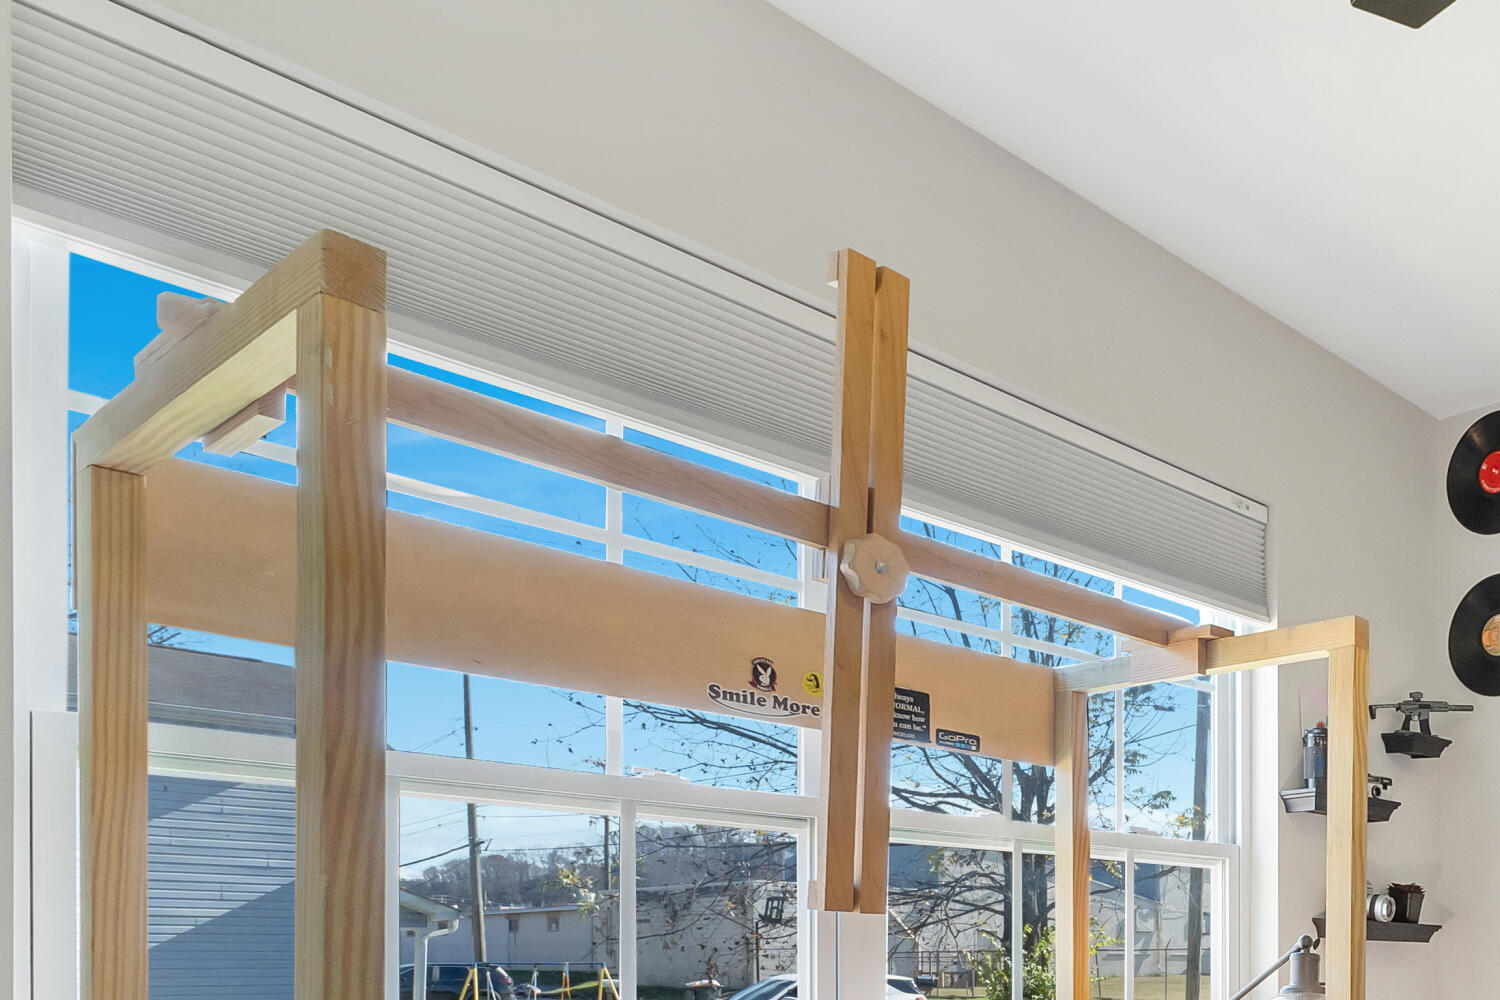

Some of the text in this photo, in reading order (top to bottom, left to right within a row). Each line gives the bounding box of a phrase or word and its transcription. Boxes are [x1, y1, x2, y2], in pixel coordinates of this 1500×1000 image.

[708, 683, 821, 717] Smile More
[894, 691, 914, 704] lways
[937, 730, 978, 746] GoPro
